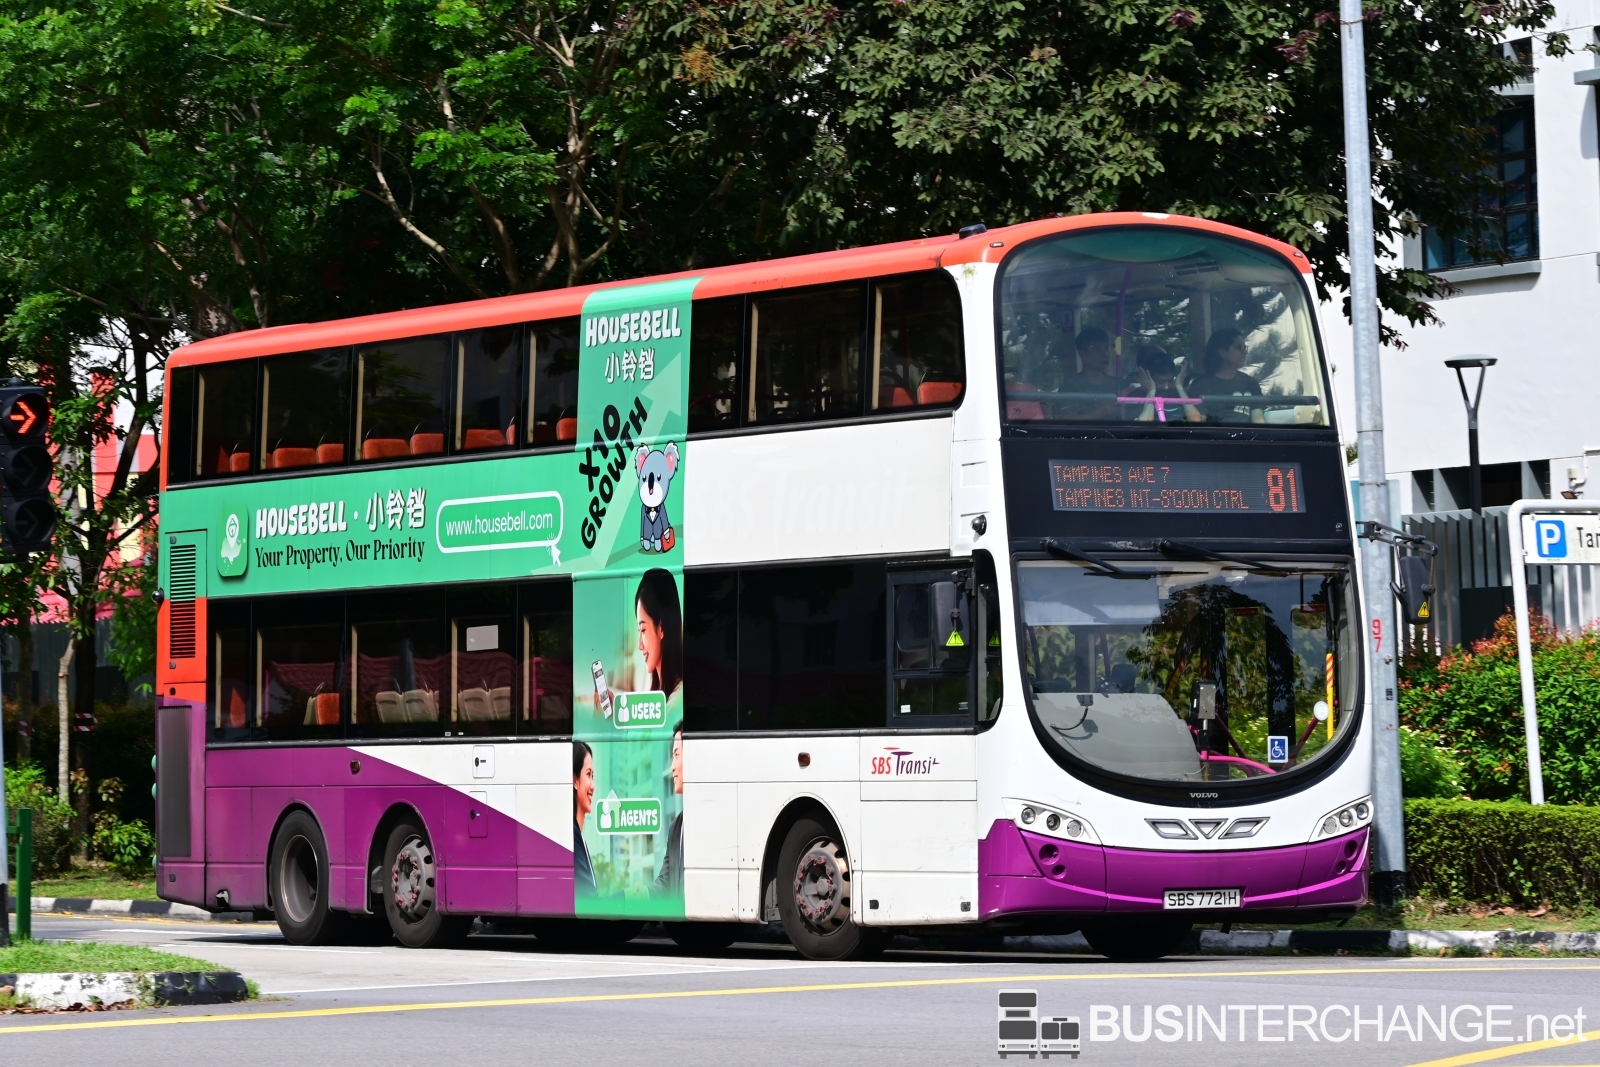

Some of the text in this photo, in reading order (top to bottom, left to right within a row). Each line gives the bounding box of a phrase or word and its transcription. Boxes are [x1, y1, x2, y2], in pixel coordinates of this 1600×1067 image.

[585, 308, 681, 347] HOUSEBELL
[604, 347, 655, 383] 小铃铛
[579, 404, 621, 492] X10
[581, 396, 648, 549] GROWTH
[1053, 465, 1170, 483] TAMPINES AVE 7
[1055, 488, 1125, 507] TAMPINES
[1212, 490, 1250, 509] CTRL
[1266, 468, 1298, 512] 81
[256, 501, 347, 539] HOUSEBELL
[366, 487, 427, 531] 小铃铛
[445, 511, 554, 537] www.housebell.com
[255, 537, 426, 570] Your Property, Our Priority
[1539, 522, 1562, 555] P
[631, 701, 662, 720] USERS
[871, 756, 892, 775] SBS
[620, 809, 658, 827] AGENTS
